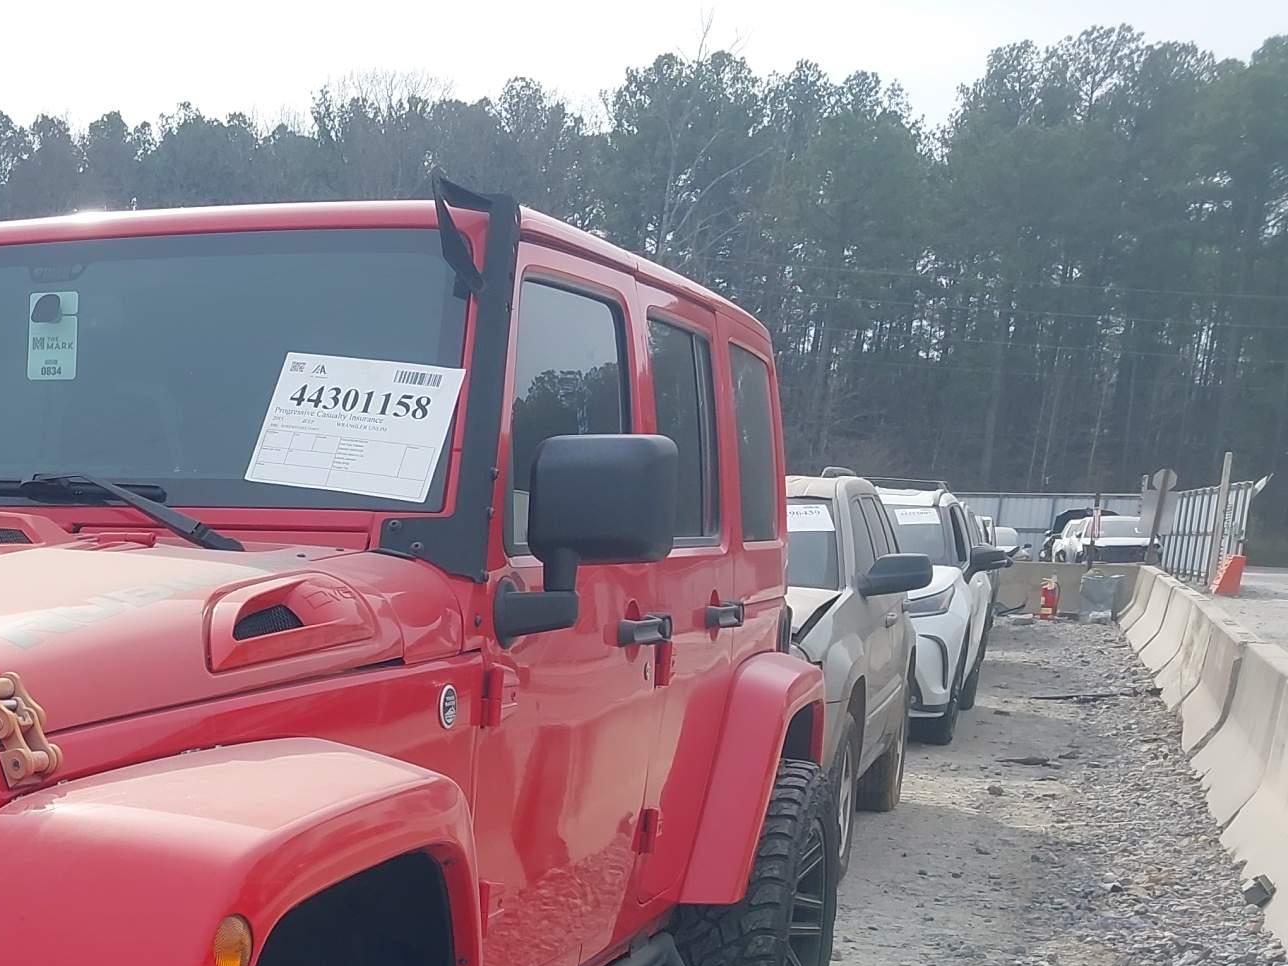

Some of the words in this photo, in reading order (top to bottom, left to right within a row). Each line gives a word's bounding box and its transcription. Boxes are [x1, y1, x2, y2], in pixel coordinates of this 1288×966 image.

[46, 342, 74, 350] MARK
[289, 383, 432, 420] 44301158
[274, 406, 315, 417] Progressive
[317, 410, 346, 421] Casualty
[349, 413, 384, 424] Insurance
